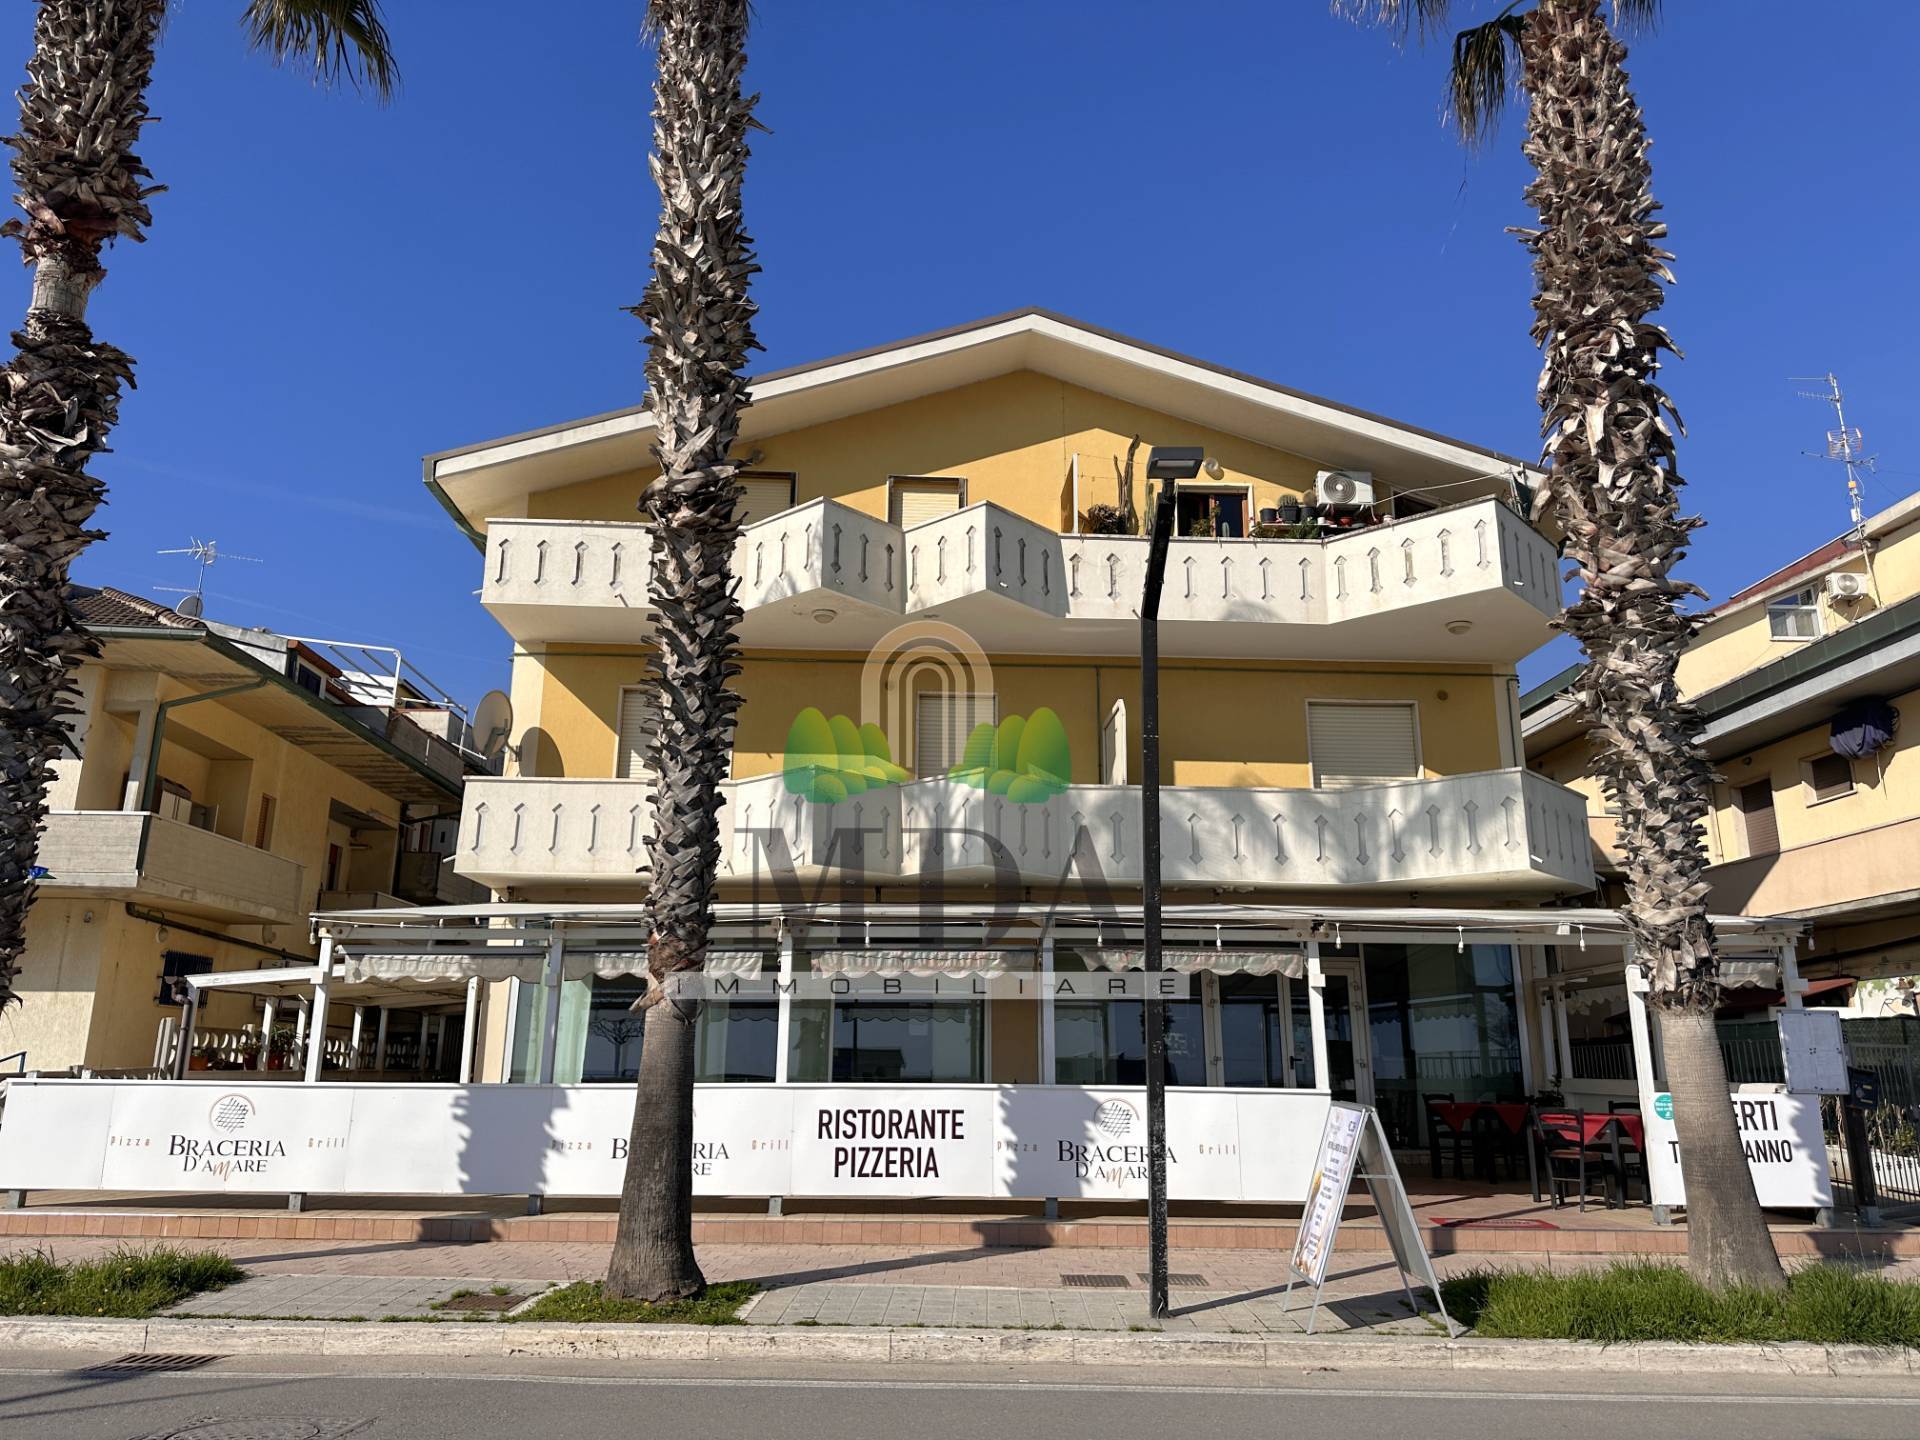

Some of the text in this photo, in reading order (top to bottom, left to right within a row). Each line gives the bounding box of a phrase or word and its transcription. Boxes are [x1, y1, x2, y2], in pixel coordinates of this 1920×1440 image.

[818, 1109, 965, 1139] RISTORANTE
[168, 1135, 286, 1157] BRACERIA
[1057, 1140, 1177, 1163] BRACERA
[834, 1147, 939, 1177] PIZZERIA
[1075, 1162, 1149, 1188] D'AMAR
